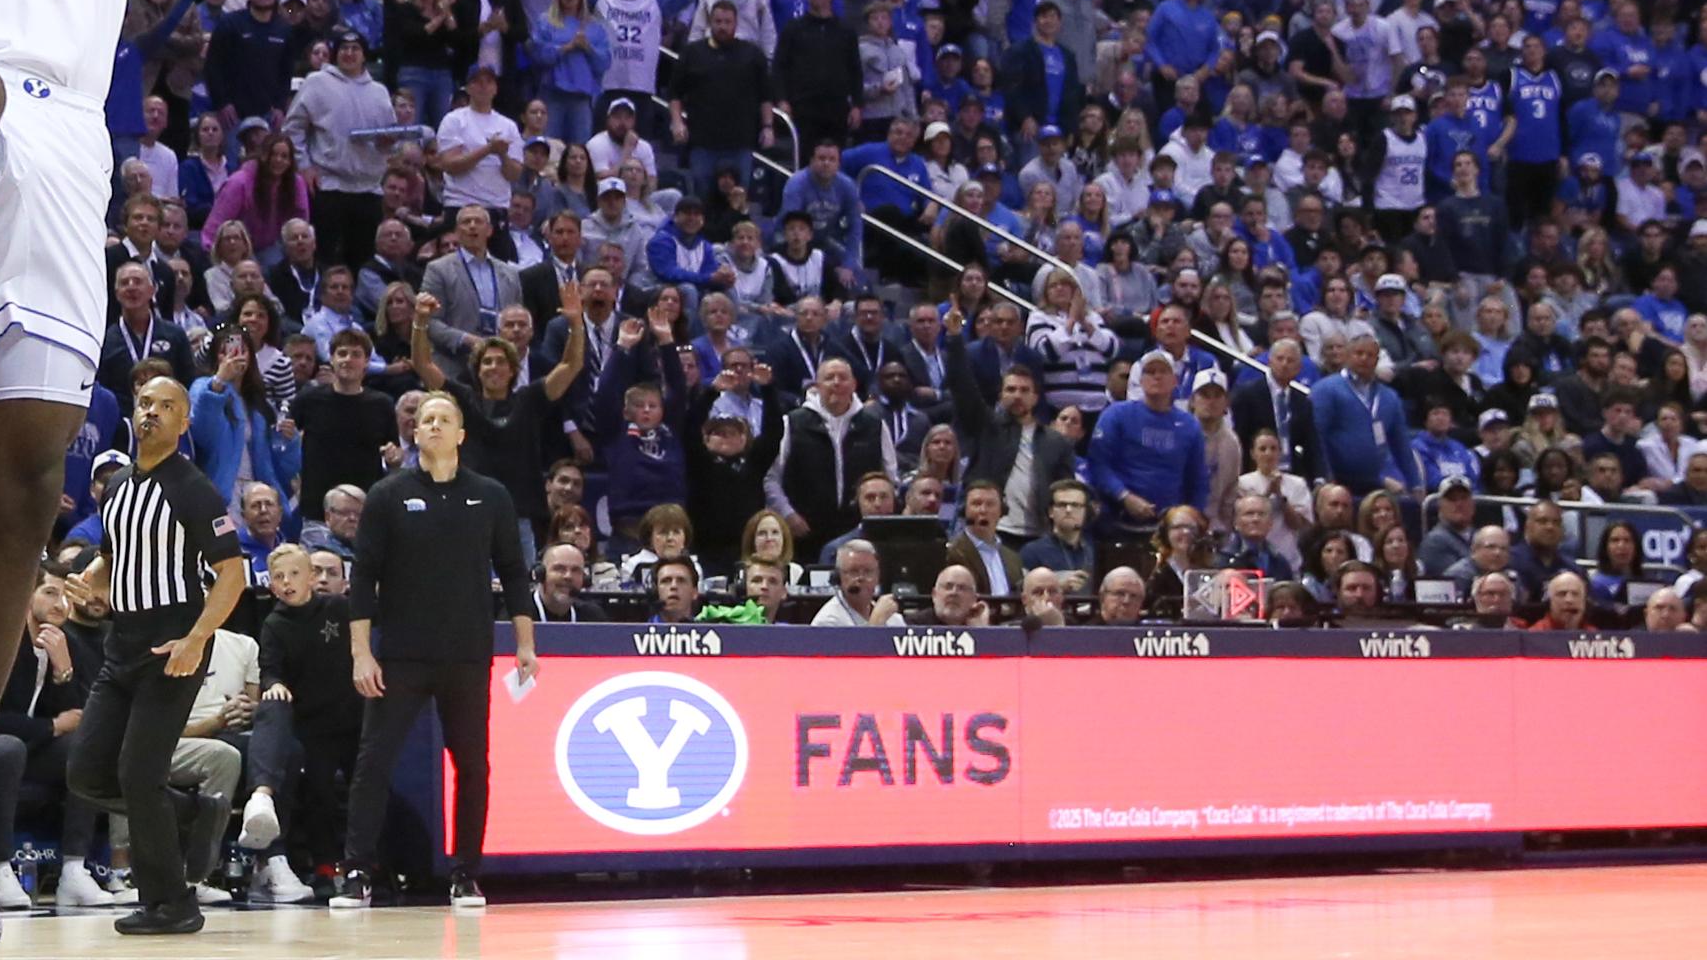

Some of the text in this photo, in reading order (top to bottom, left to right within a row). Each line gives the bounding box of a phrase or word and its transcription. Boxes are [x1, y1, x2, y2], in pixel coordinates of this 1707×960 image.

[617, 25, 642, 44] 32
[633, 626, 703, 656] vivint
[893, 627, 958, 657] vivint
[1133, 629, 1193, 657] vivint
[1359, 631, 1415, 658] vivint
[1568, 633, 1620, 659] vivint
[795, 711, 1012, 787] FANS
